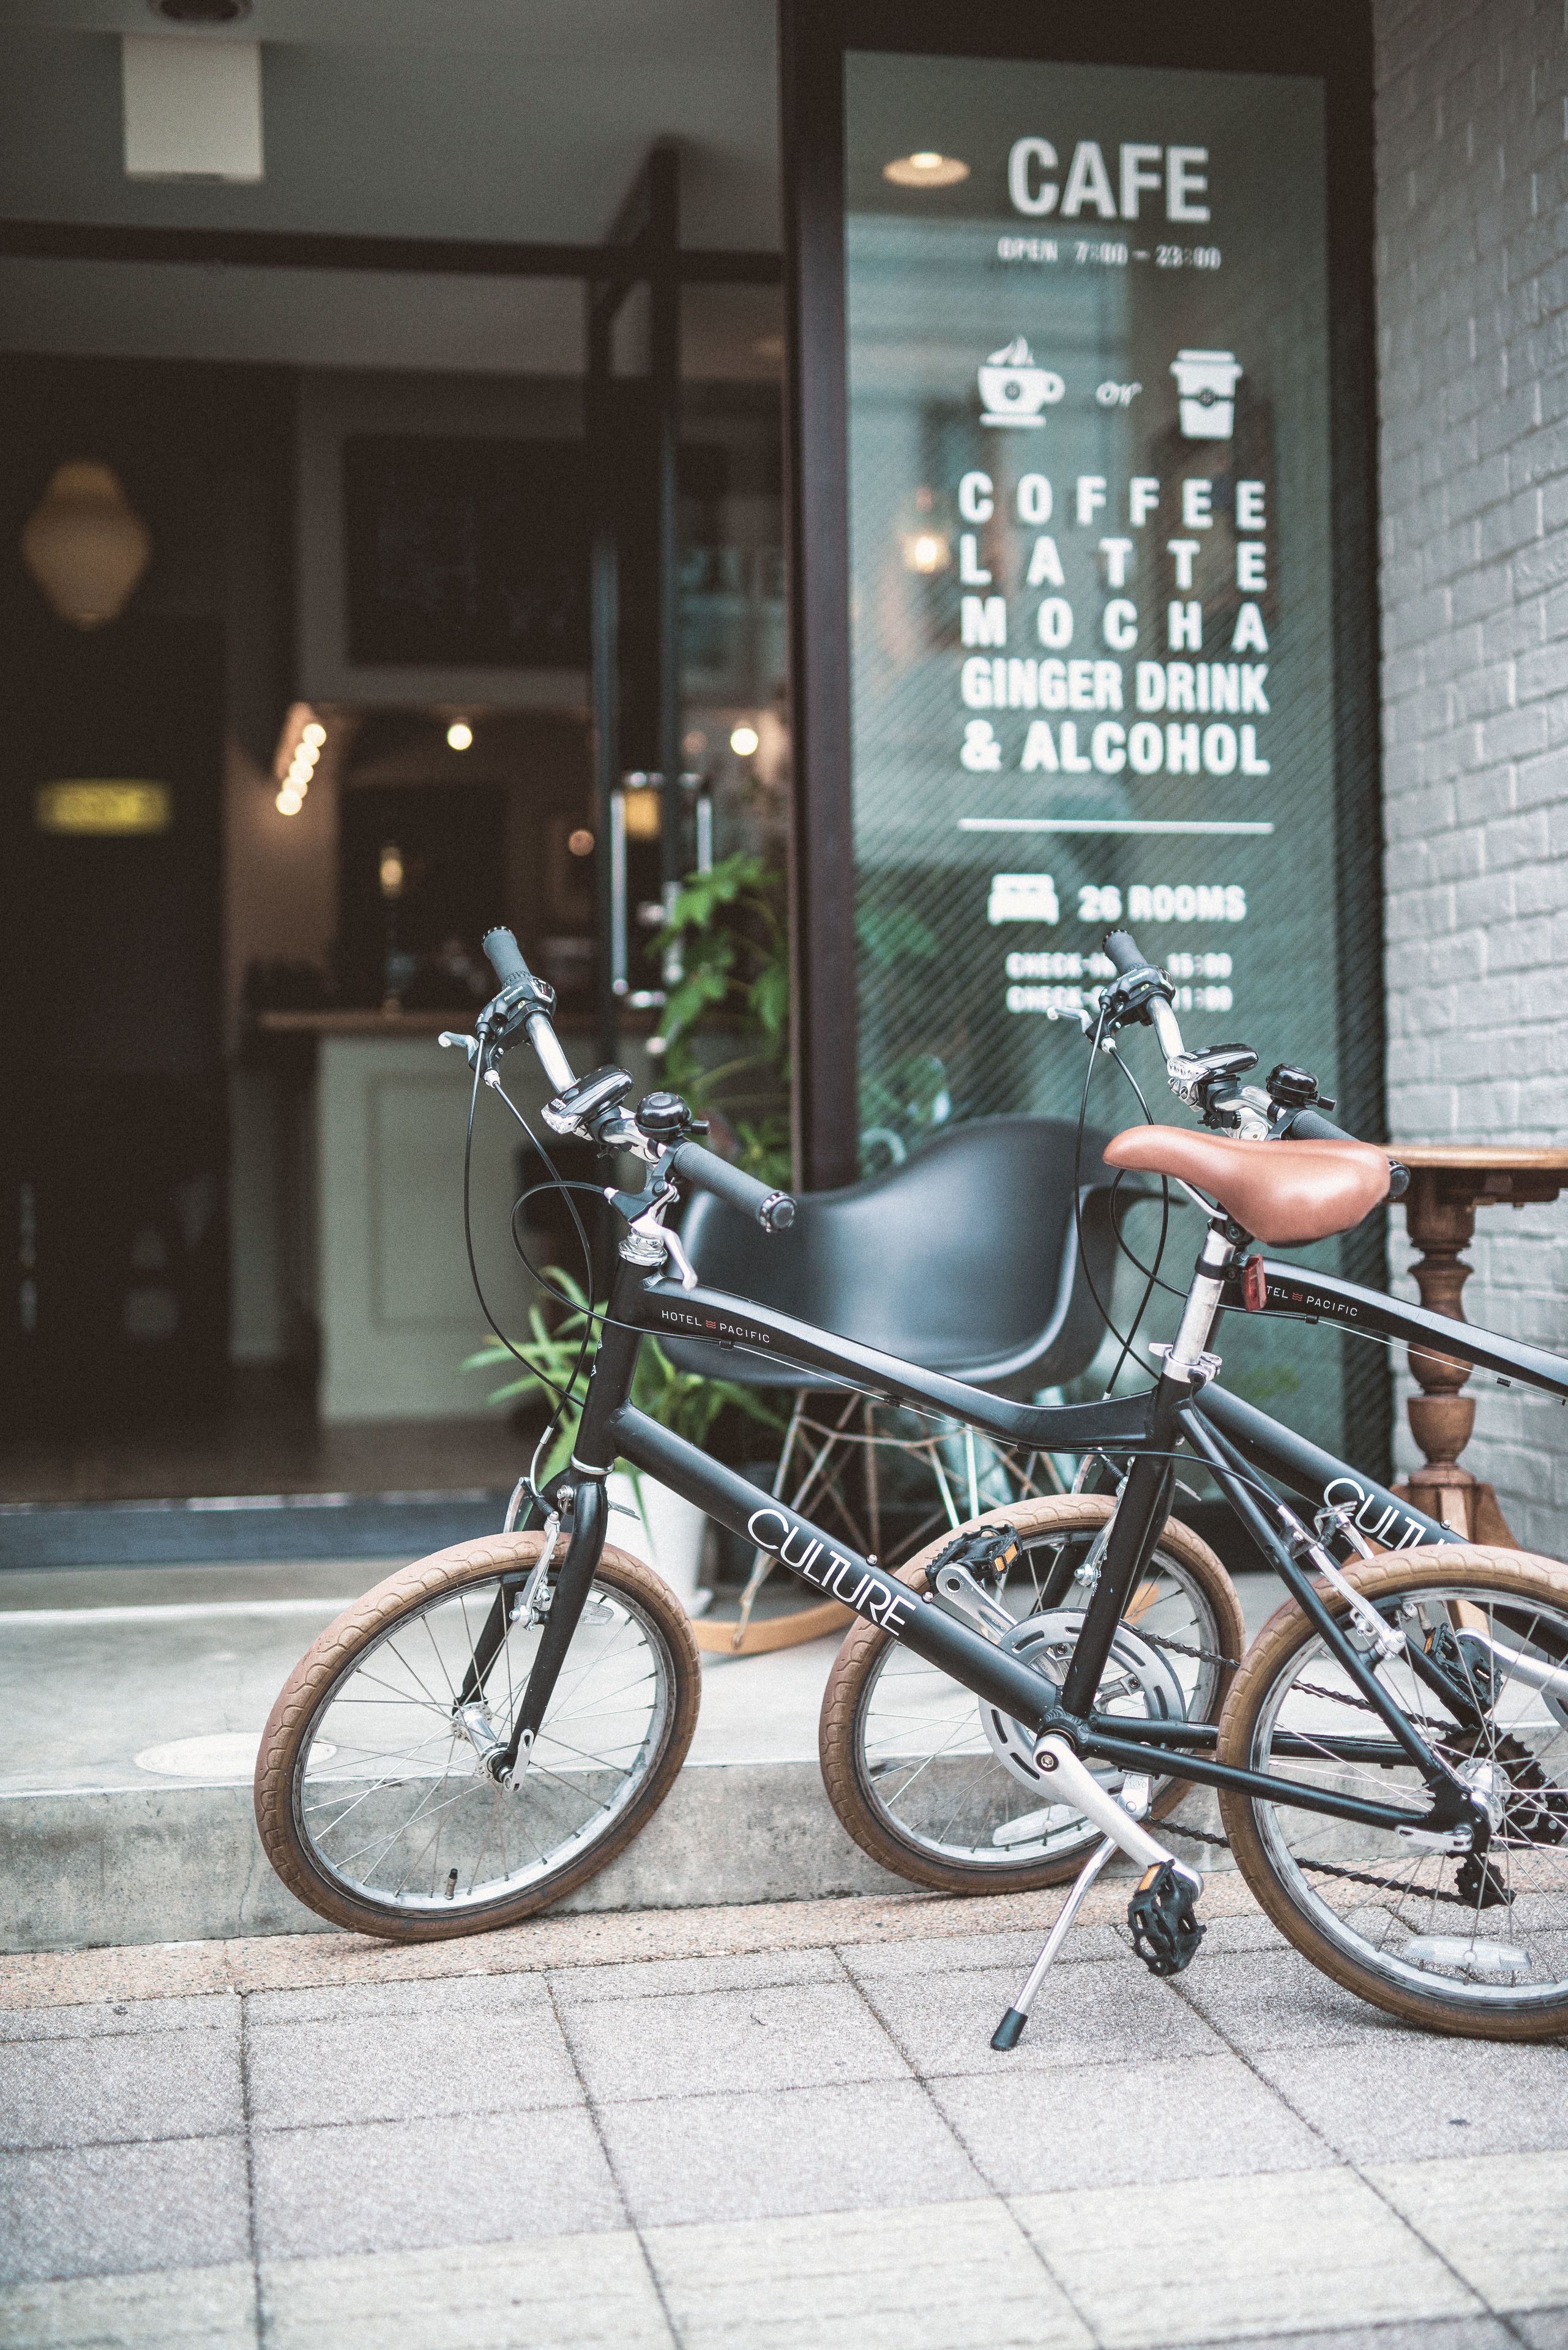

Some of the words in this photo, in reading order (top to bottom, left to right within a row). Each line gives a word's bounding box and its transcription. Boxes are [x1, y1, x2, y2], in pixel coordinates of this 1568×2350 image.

[1008, 137, 1211, 223] CAFE
[998, 237, 1058, 262] OPEN
[1075, 241, 1128, 266] 7:00
[1155, 245, 1221, 270] 23:00
[1096, 381, 1143, 408] or
[958, 472, 1266, 530] COFFEE
[959, 534, 1267, 591] LATTE
[960, 595, 1269, 652] MOCHA
[961, 657, 1123, 712] GINGER
[1136, 660, 1270, 714] DRINK
[960, 720, 1002, 772] &
[1020, 720, 1270, 775] ALCOHOL
[1078, 884, 1122, 922] 26
[1128, 884, 1247, 922] ROOMS
[662, 1310, 702, 1326] HOTEL
[720, 1323, 770, 1343] PACIFIC
[1266, 1285, 1288, 1299] TEL
[1307, 1296, 1357, 1316] PACIFIC
[1323, 1477, 1452, 1551] CULT
[747, 1509, 916, 1636] CULTURE
